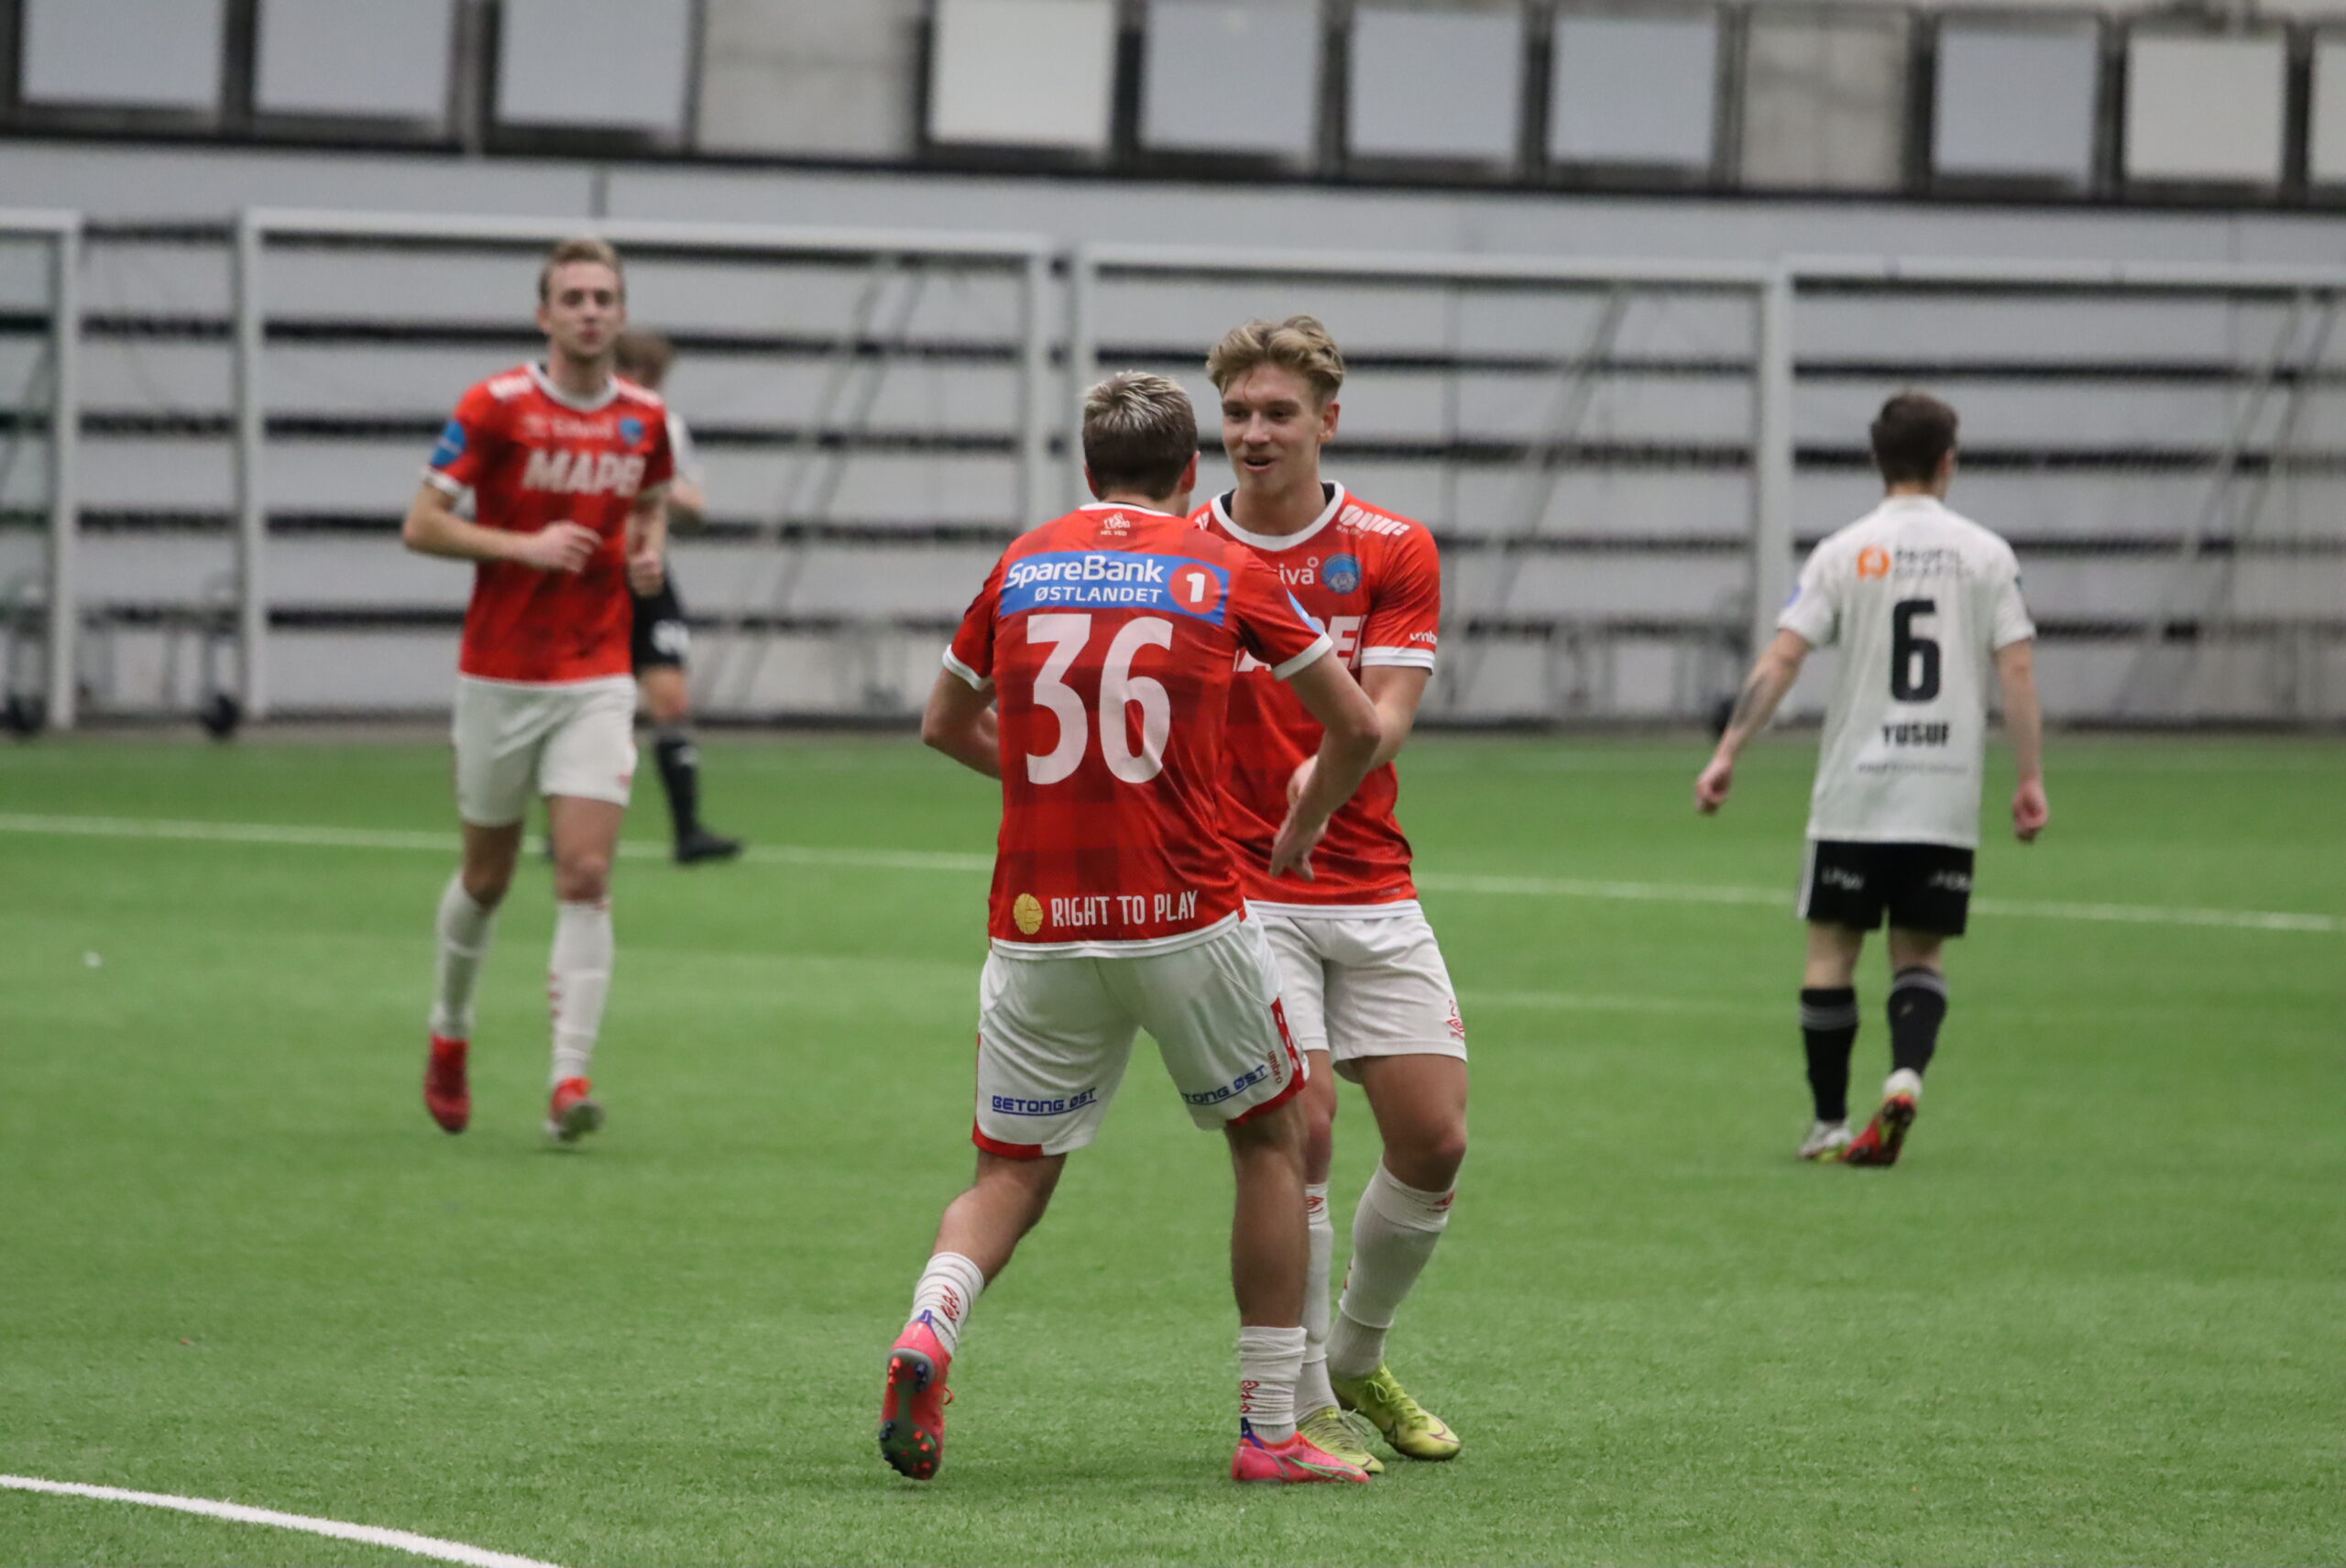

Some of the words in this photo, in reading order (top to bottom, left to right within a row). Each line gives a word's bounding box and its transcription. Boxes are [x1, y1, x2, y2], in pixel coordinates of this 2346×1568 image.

[1006, 554, 1165, 589] SpareBank
[1186, 572, 1206, 603] 1
[1034, 586, 1163, 603] ØSTLANDET
[1891, 598, 1942, 704] 6
[1026, 613, 1174, 785] 36
[1882, 721, 1950, 747] YUSUF
[1050, 896, 1110, 927] RIGHT
[1116, 895, 1146, 925] TO
[1154, 890, 1199, 923] PLAY
[1267, 1050, 1284, 1084] umbro
[992, 1094, 1065, 1113] BETONG
[1069, 1086, 1097, 1109] ØST
